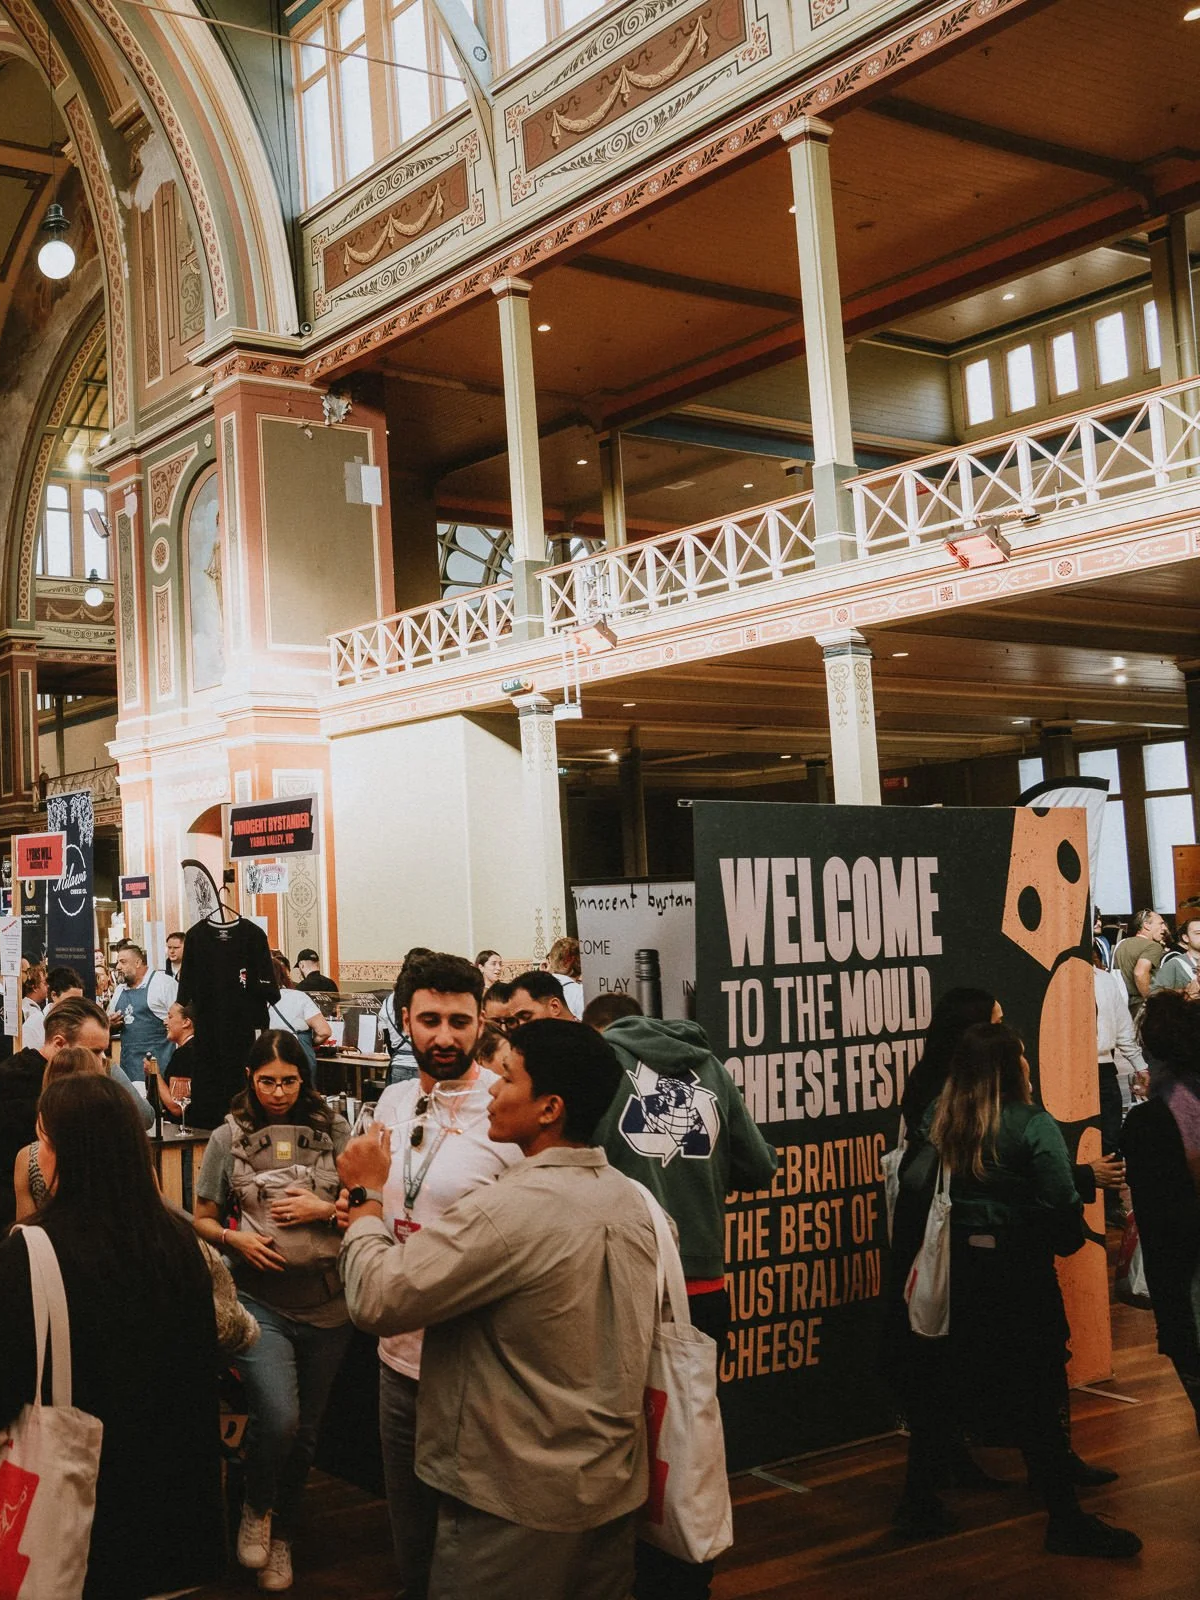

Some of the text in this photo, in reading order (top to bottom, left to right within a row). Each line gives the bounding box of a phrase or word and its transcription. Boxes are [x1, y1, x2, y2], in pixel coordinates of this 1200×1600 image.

[233, 812, 310, 836] INNOCENT BYSTANDER
[250, 836, 266, 848] YARRA
[572, 884, 637, 910] innocent
[719, 856, 943, 967] WELCOME
[600, 978, 630, 993] PLAY
[721, 966, 932, 1048] TO THE MOULD
[724, 1048, 841, 1124] CHEESE
[724, 1191, 878, 1264] THE BEST OF
[719, 1317, 822, 1384] CHEESE
